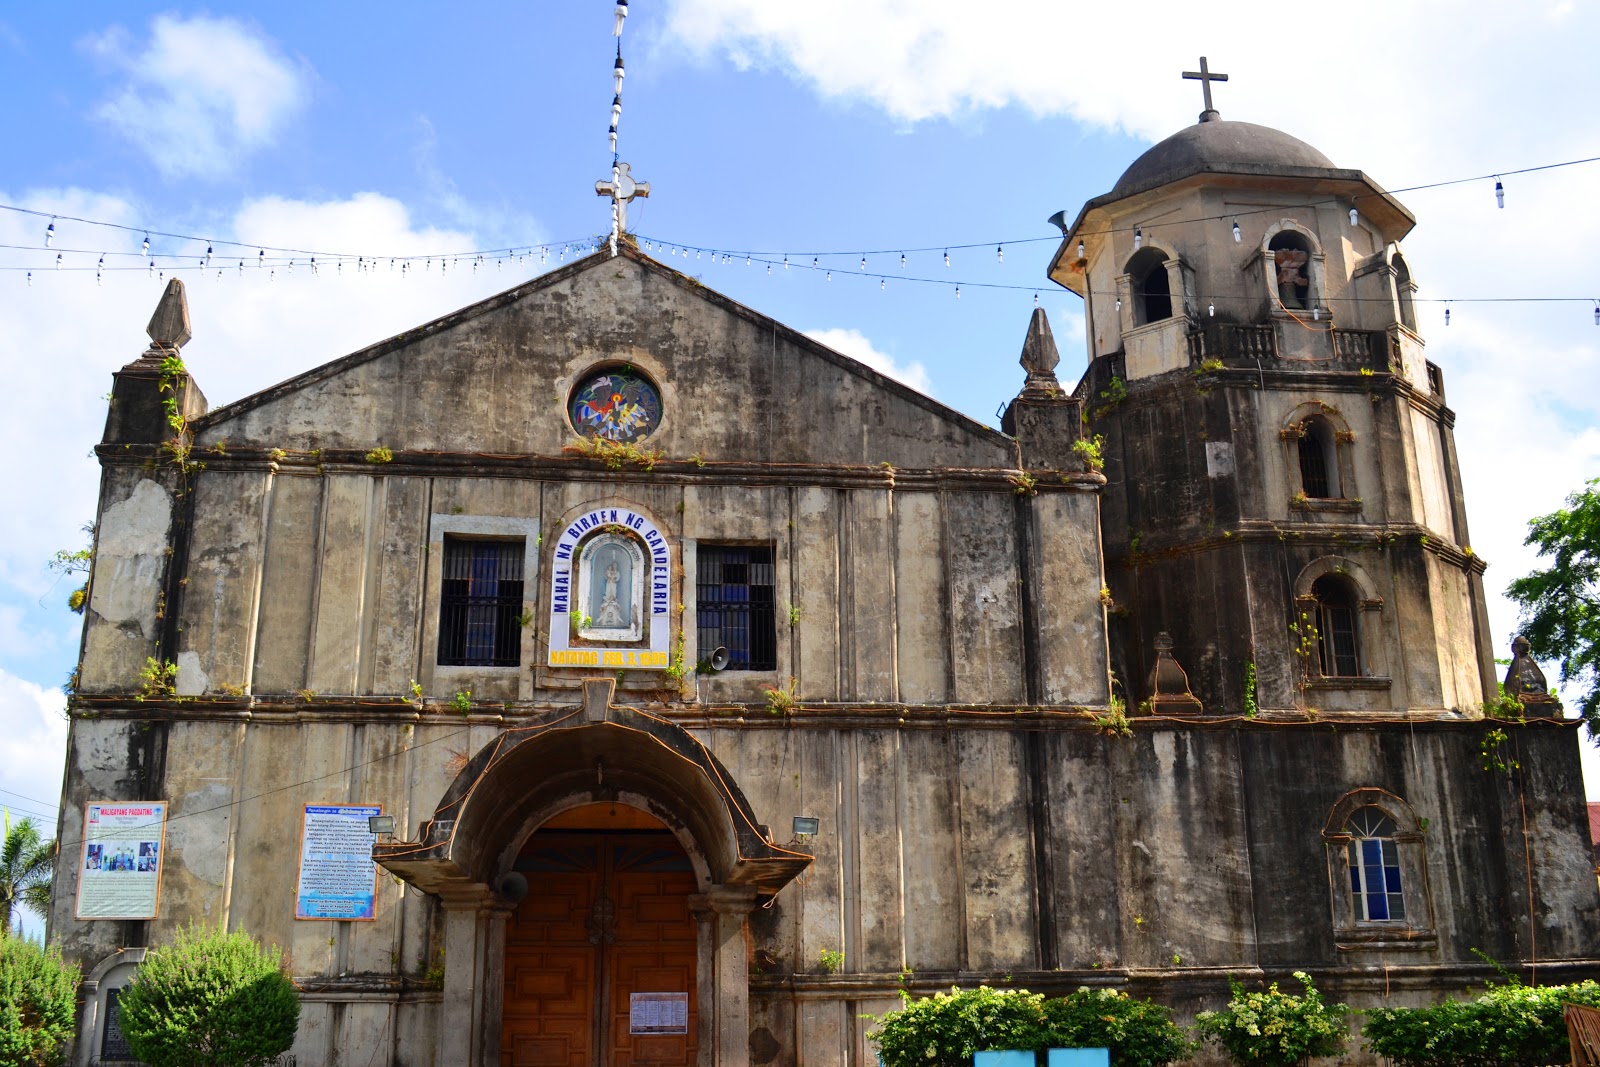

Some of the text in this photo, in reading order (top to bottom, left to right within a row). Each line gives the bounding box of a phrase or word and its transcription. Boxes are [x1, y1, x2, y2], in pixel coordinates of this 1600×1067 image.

[568, 510, 618, 538] BIRHEN
[625, 512, 644, 530] NG
[556, 542, 572, 560] NA
[645, 529, 667, 614] CANDELARIA
[554, 570, 570, 612] MAHAL
[550, 650, 598, 665] NATATAG
[603, 651, 624, 666] FEB.
[638, 652, 668, 666] 1595
